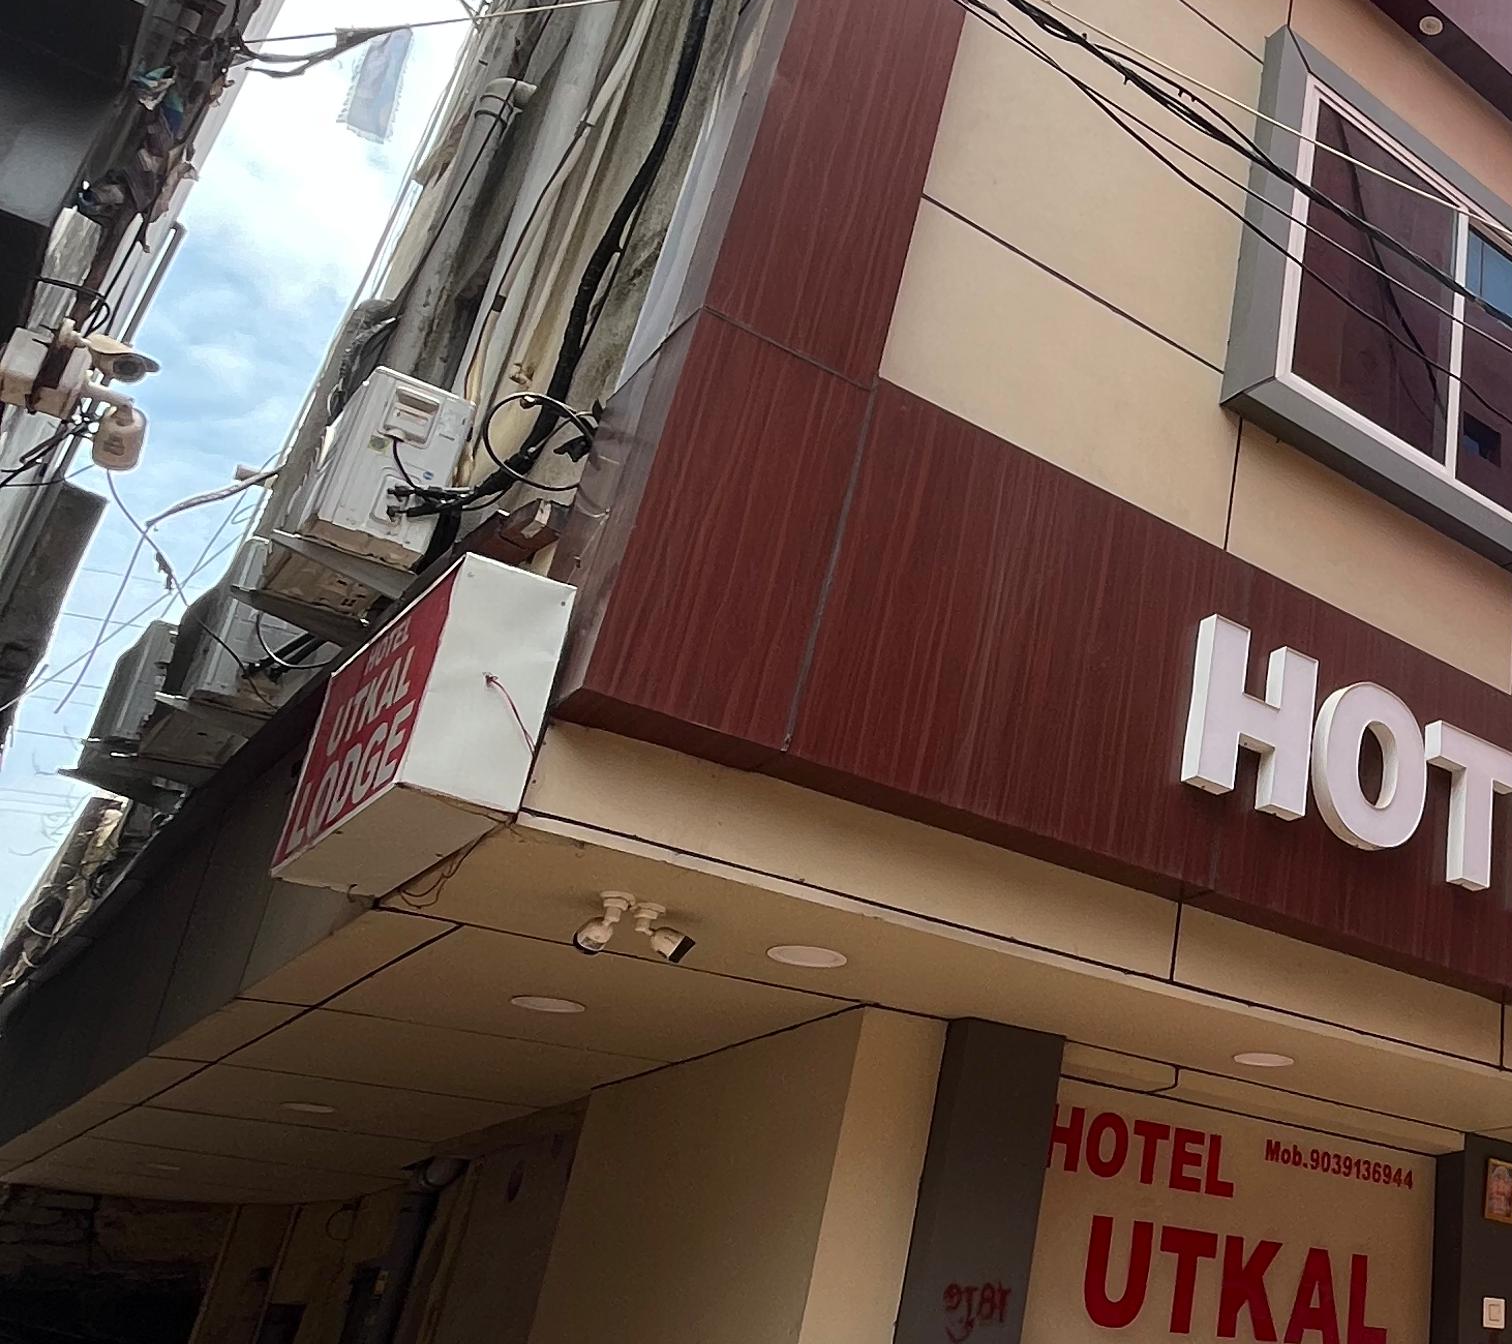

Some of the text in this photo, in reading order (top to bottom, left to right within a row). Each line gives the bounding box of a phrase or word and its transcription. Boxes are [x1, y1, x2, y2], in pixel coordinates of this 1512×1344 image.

[366, 616, 411, 675] HOTEL
[325, 647, 415, 757] UTKAL
[288, 700, 414, 854] LODGE
[1046, 1104, 1414, 1199] HOTEL Mob.9039136944
